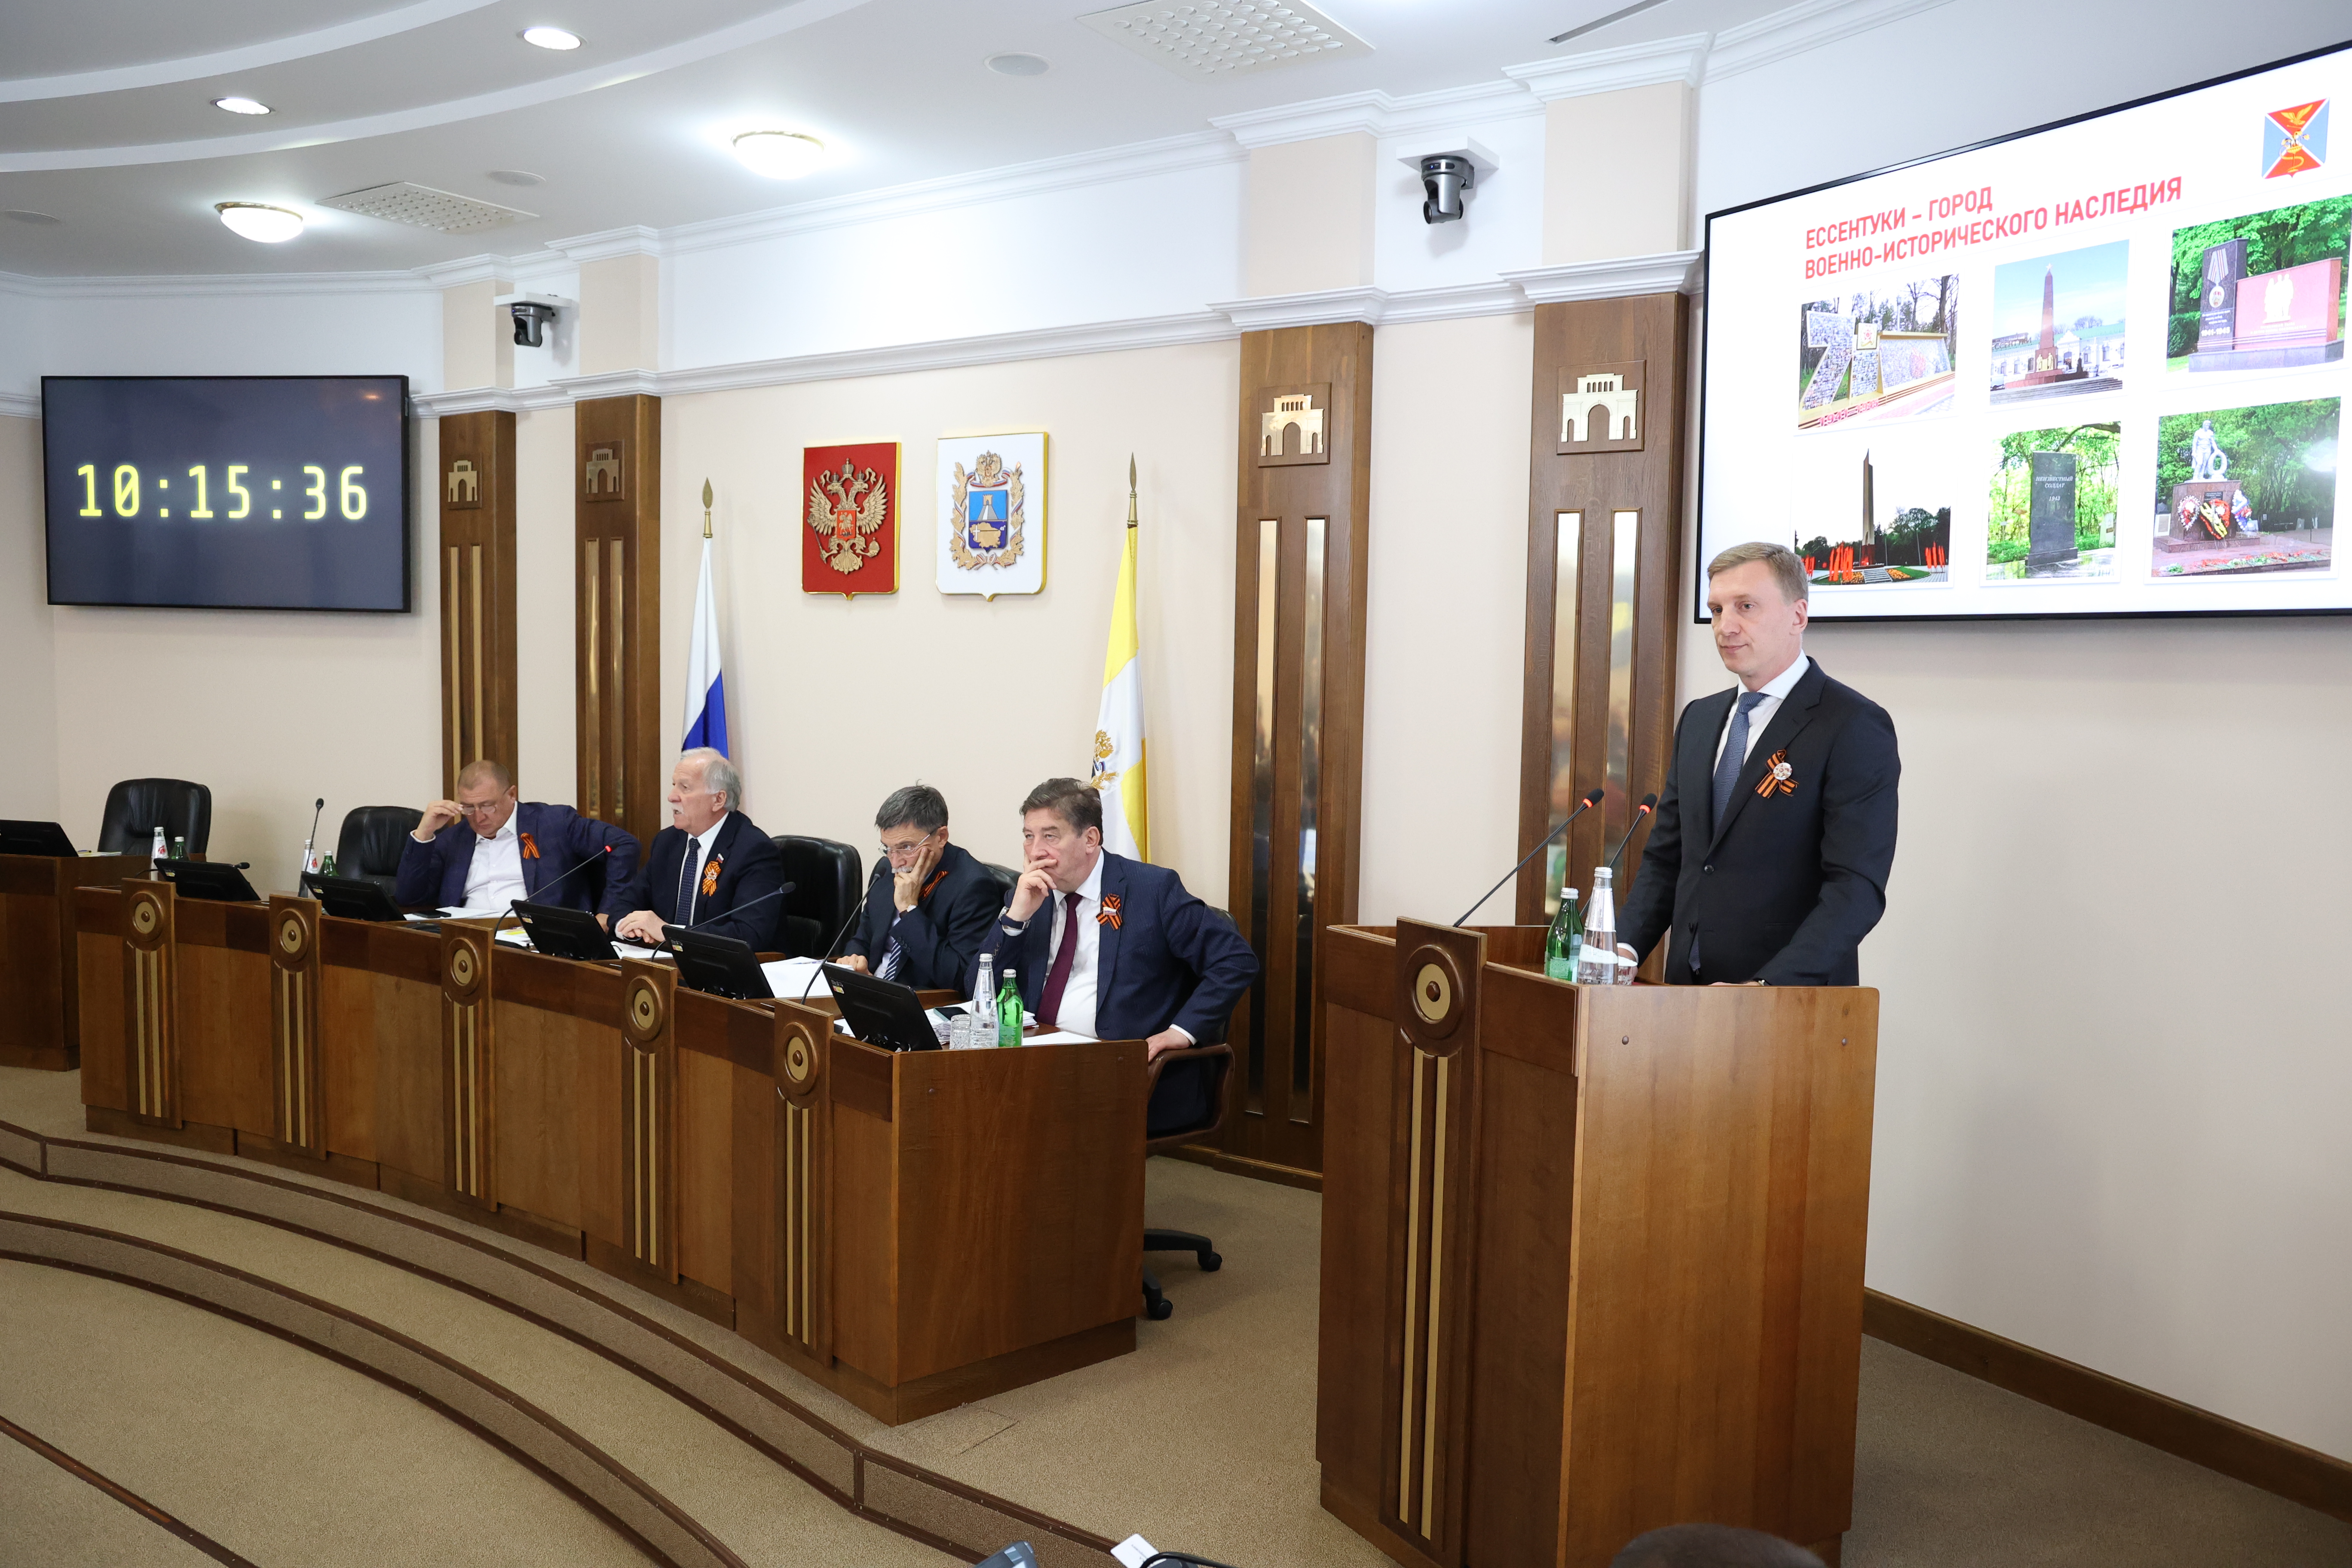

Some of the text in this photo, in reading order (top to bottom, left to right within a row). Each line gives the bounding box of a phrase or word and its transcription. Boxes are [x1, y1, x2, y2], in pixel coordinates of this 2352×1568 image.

[1805, 176, 2182, 279] ВОЕННО-ИСТОРИЧЕСКОГО НАСЛЕДИЯ
[1806, 207, 1906, 249] ЕССЕНТУКИ
[1929, 187, 1993, 221] ГОРОД
[78, 464, 367, 520] 10:15:36
